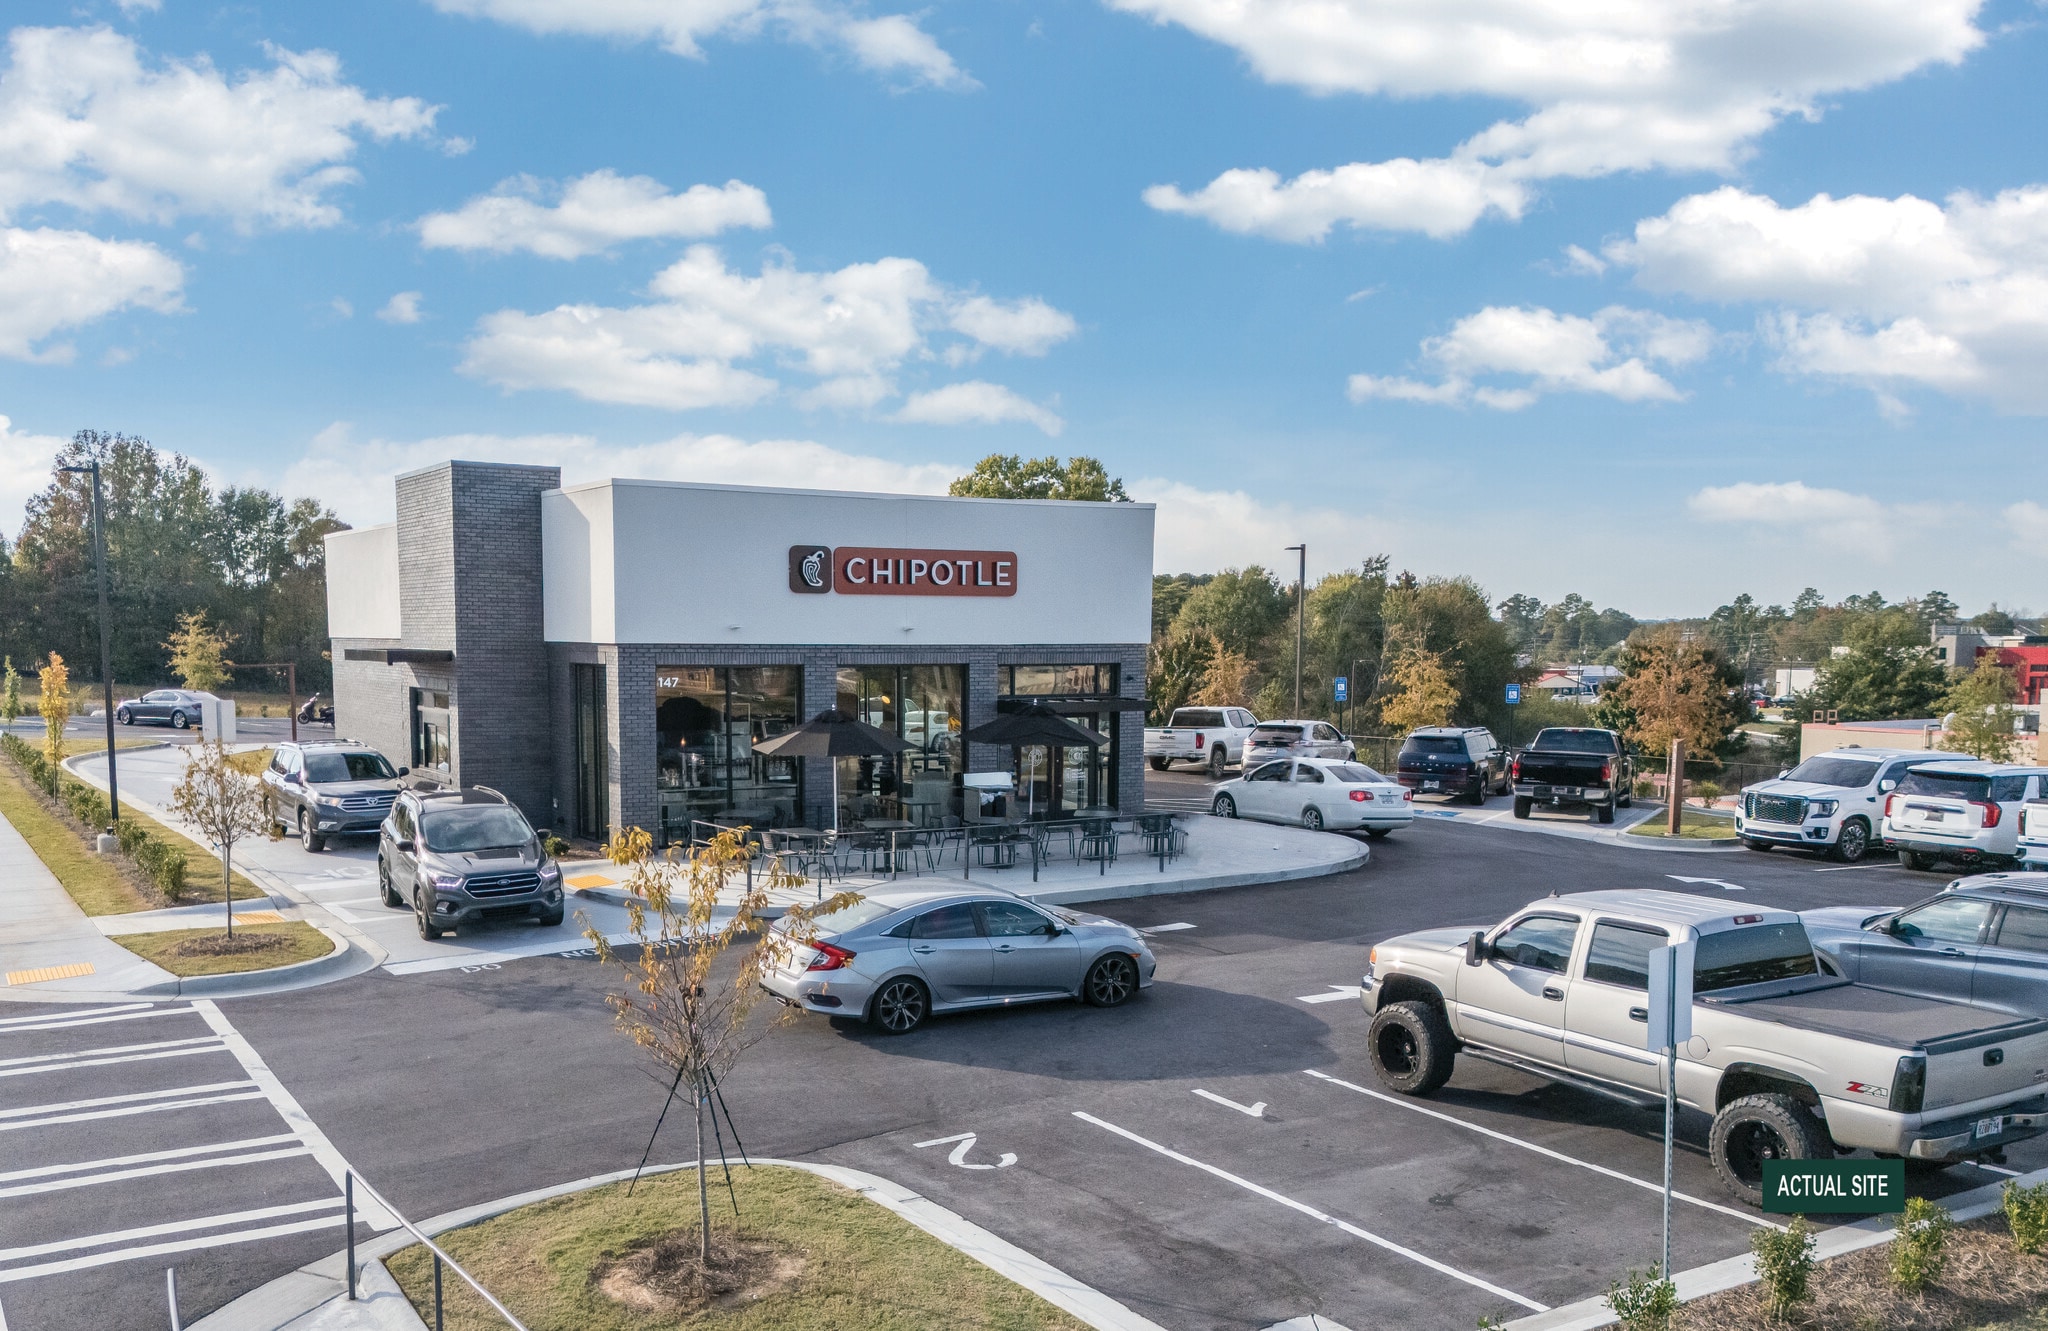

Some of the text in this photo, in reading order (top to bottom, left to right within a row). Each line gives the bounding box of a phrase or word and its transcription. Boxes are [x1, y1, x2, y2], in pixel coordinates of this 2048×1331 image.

[844, 557, 1012, 586] CHIPOTLE
[658, 676, 679, 688] 147
[460, 962, 502, 974] DO
[1846, 1080, 1889, 1099] Z71
[913, 1132, 1018, 1170] 2
